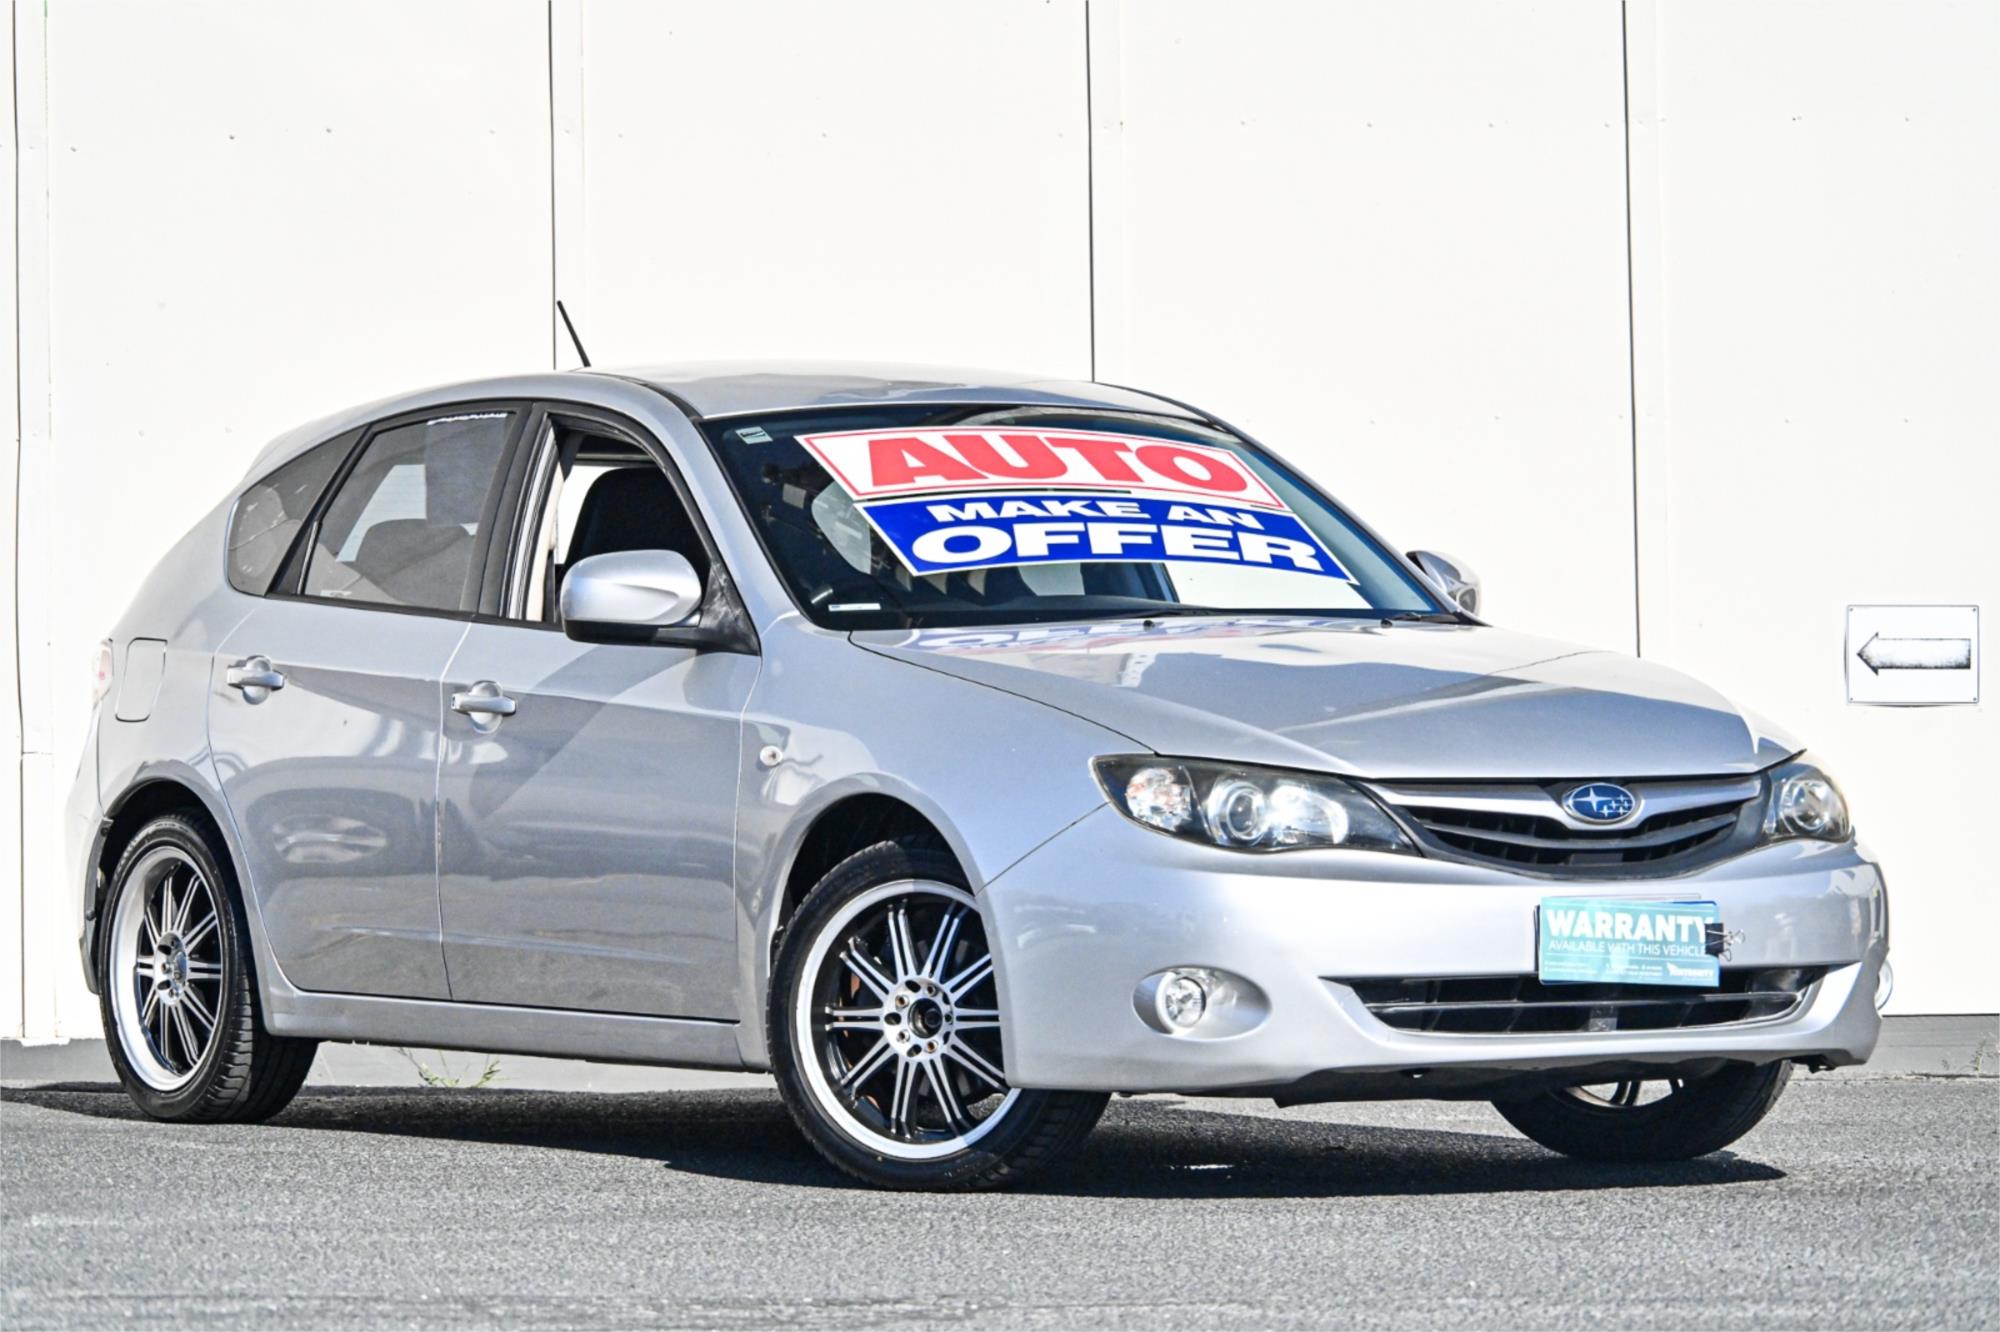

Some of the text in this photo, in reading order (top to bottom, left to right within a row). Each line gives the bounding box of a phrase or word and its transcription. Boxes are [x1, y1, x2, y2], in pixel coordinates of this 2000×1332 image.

[867, 434, 1249, 492] AUTO
[925, 499, 1265, 531] MAKE AN
[911, 522, 1326, 572] OFFER
[1546, 909, 1714, 944] WARRANTY
[1549, 939, 1605, 953] AVAILABLE
[1608, 942, 1635, 955] WITH
[1638, 943, 1662, 956] THIS
